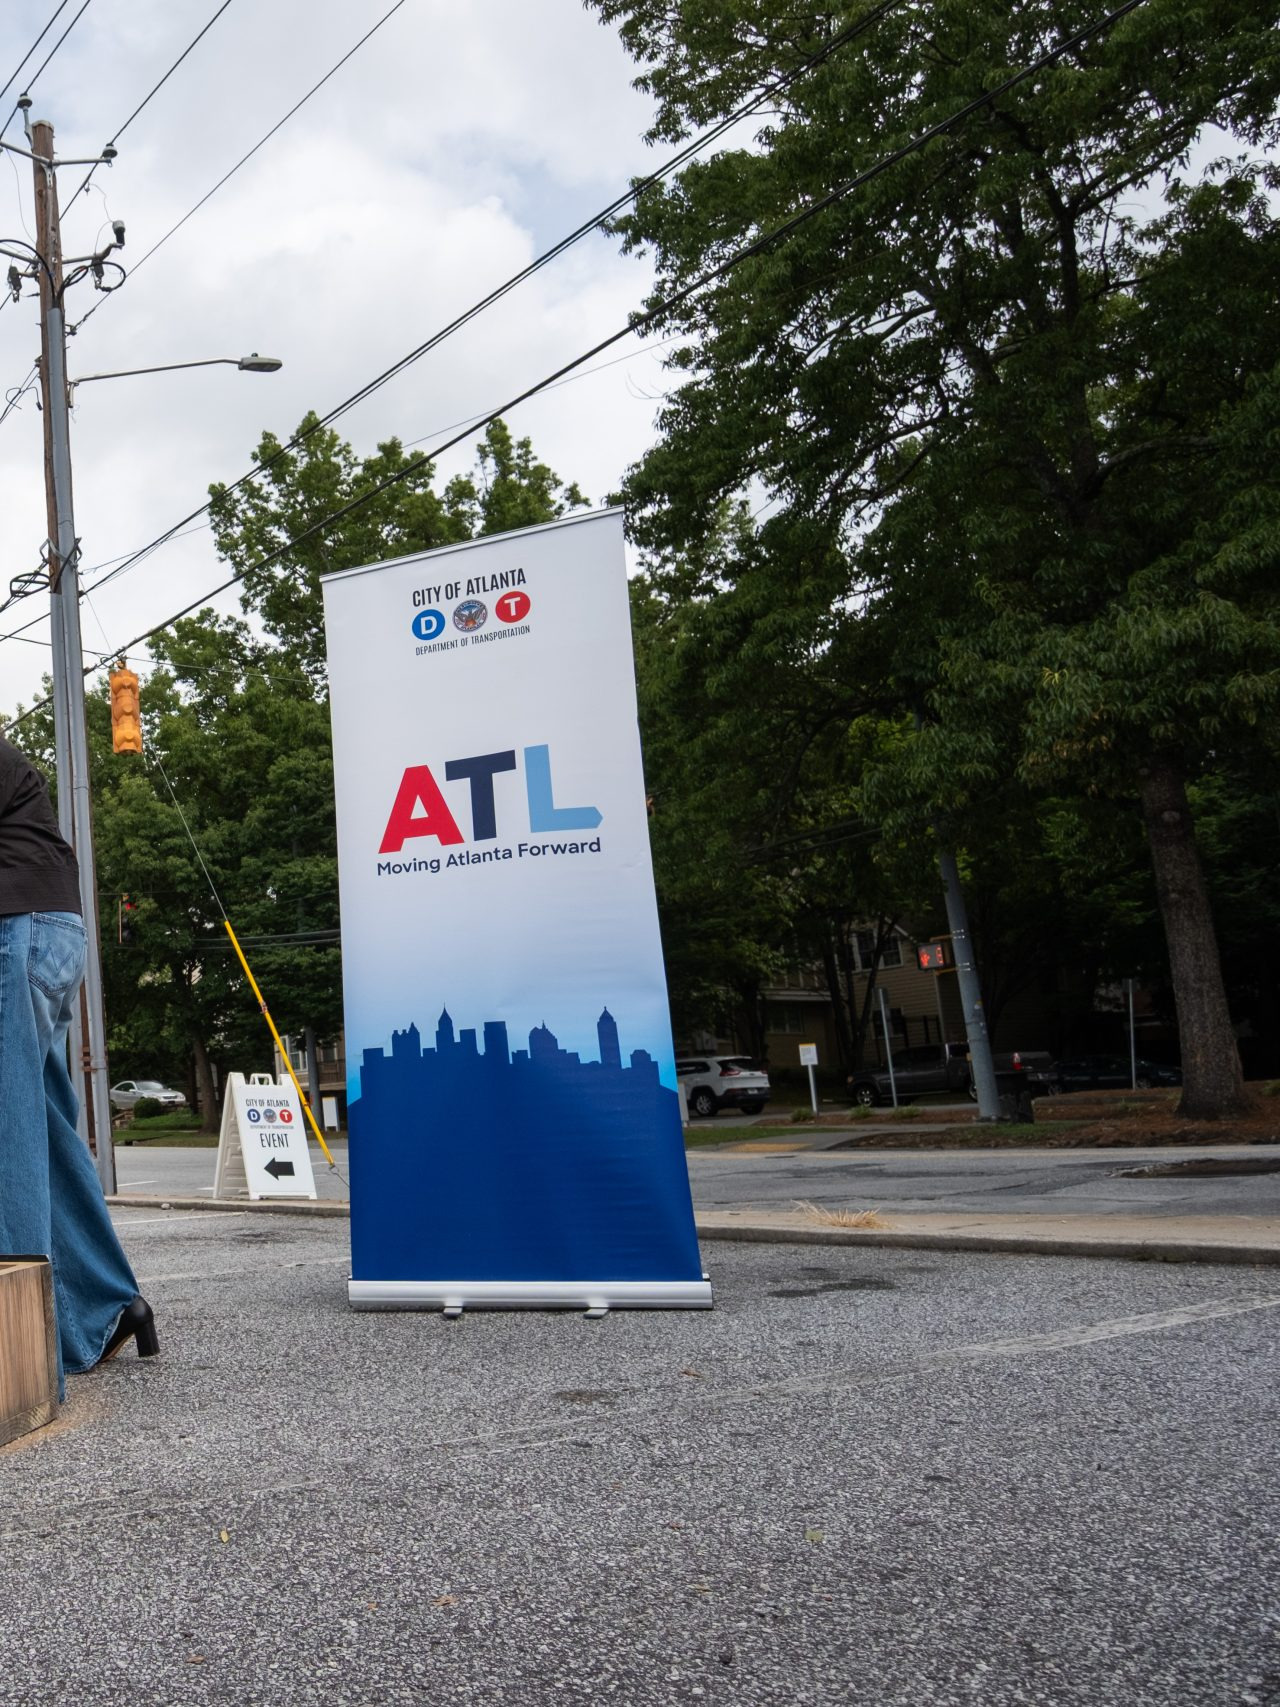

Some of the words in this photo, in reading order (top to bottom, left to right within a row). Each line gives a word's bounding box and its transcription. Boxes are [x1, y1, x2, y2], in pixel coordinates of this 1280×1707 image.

[412, 585, 441, 607] CITY
[445, 581, 461, 600] OF
[466, 567, 527, 596] ATLANTA
[420, 615, 438, 635] D
[504, 596, 521, 617] T
[415, 639, 459, 656] DEPARTMENT
[460, 637, 469, 648] OF
[471, 625, 531, 645] TRANSPORTATION
[378, 744, 604, 854] ATL
[377, 857, 441, 876] Moving
[446, 846, 513, 868] Atlanta
[517, 837, 602, 859] Forward
[246, 1098, 257, 1107] CITY
[259, 1099, 265, 1107] OF
[267, 1099, 290, 1107] ATLANTA
[250, 1111, 258, 1120] D
[282, 1112, 289, 1120] T
[259, 1133, 289, 1148] EVENT
